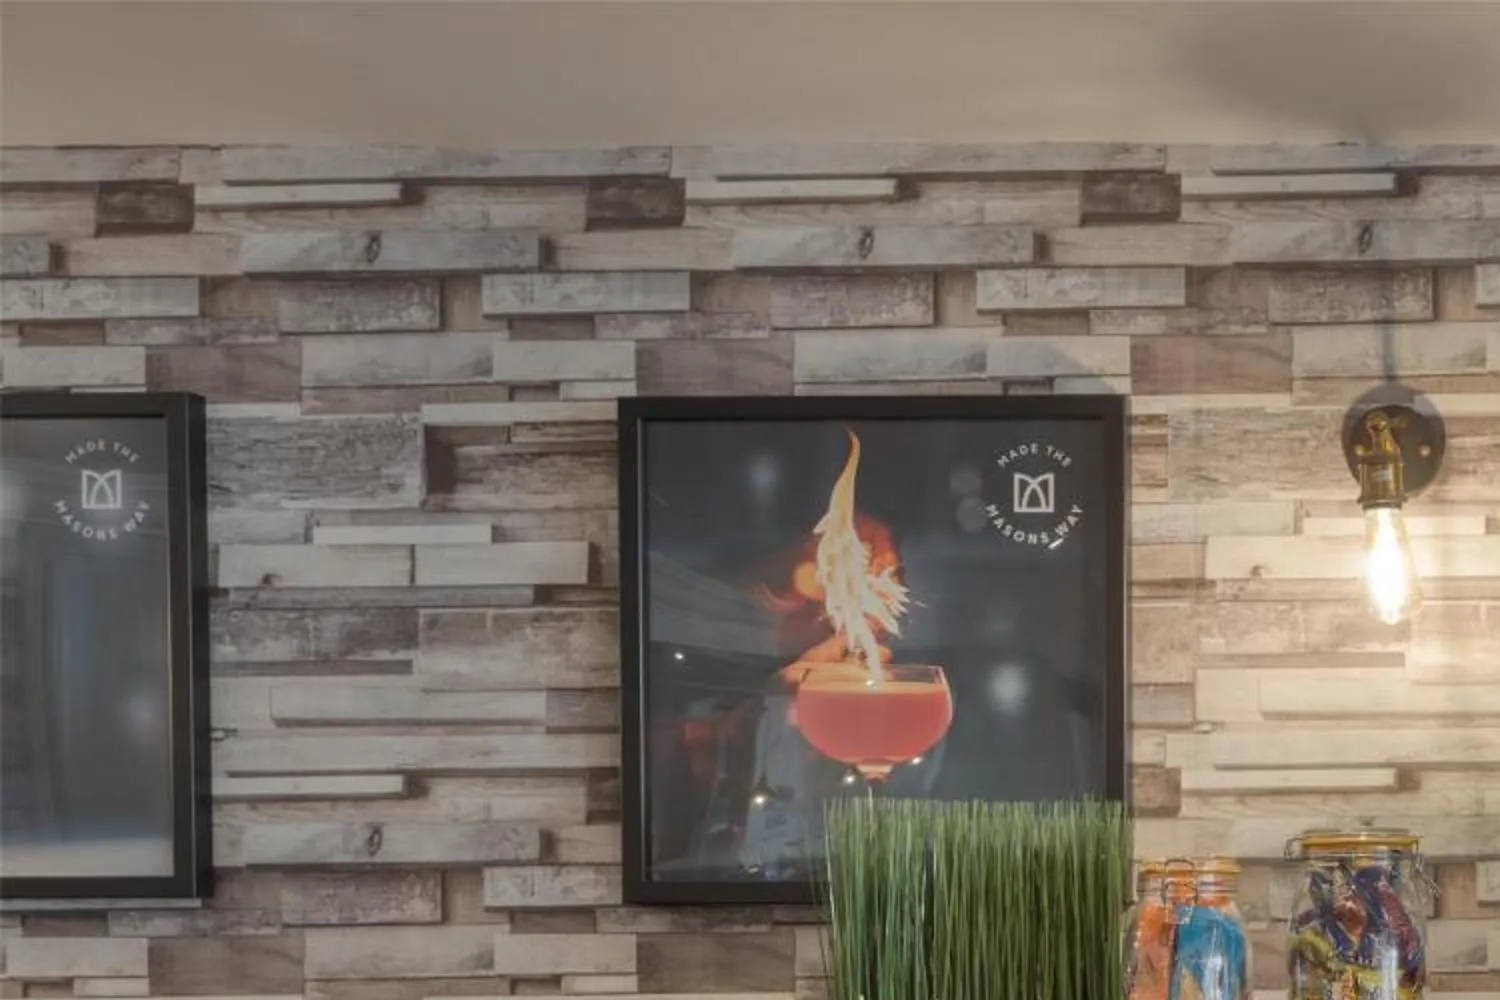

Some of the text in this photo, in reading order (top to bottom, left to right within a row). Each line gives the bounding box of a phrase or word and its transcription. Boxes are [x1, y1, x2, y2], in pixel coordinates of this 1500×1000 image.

[64, 438, 141, 464] MADE THE
[996, 442, 1072, 468] MADE THE
[54, 500, 150, 541] MASONS WAY
[985, 503, 1083, 544] MASONS WAY
